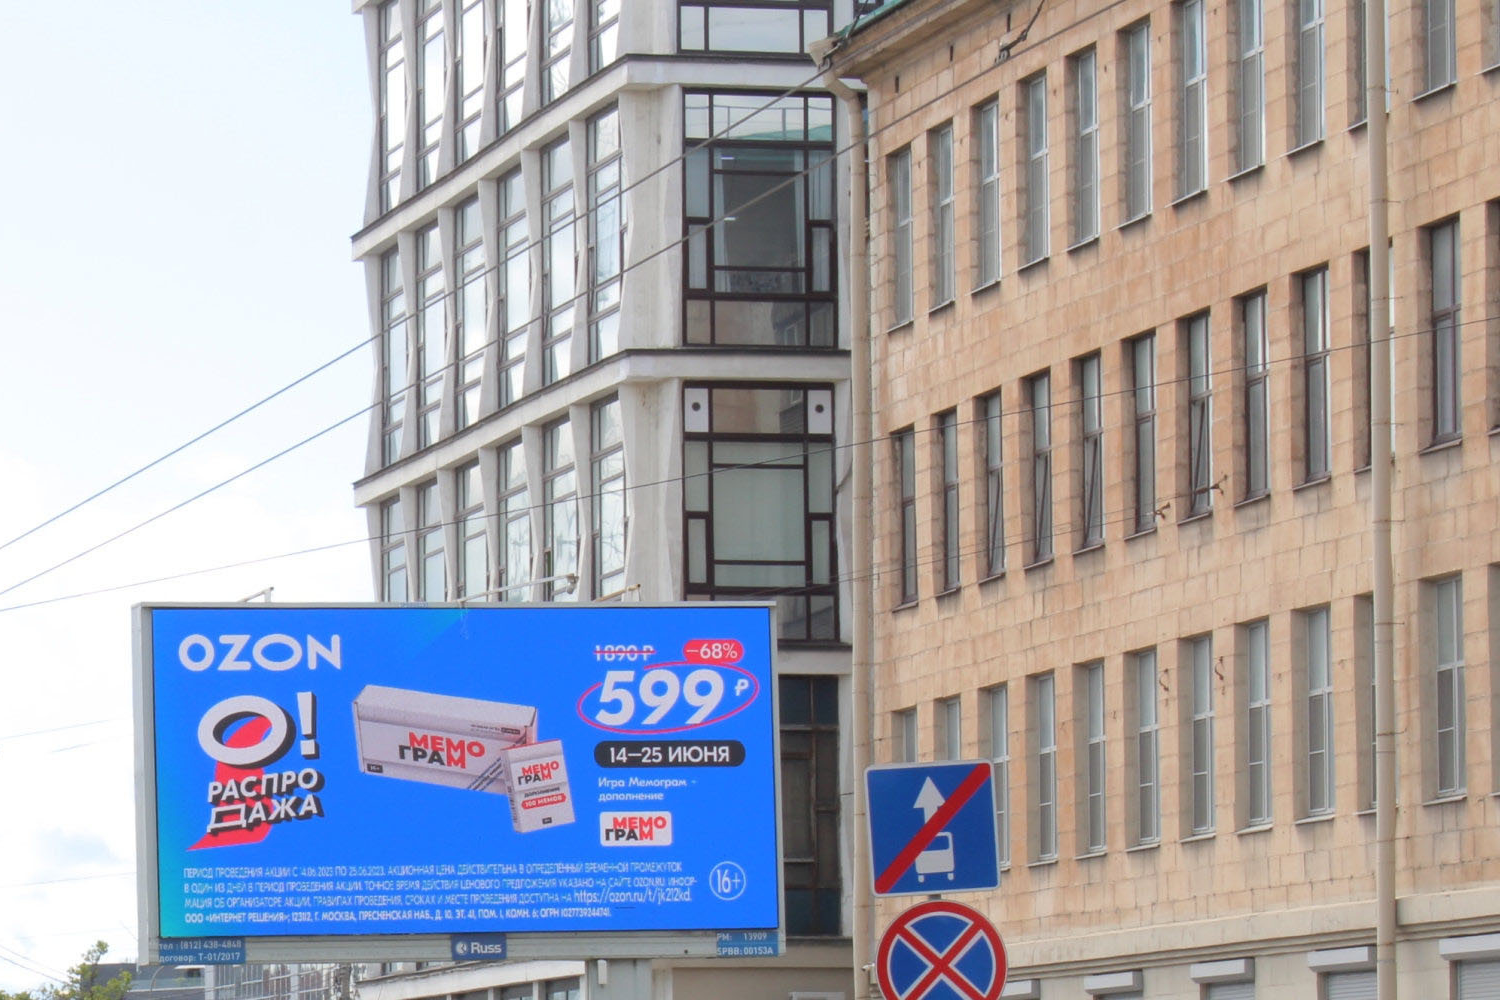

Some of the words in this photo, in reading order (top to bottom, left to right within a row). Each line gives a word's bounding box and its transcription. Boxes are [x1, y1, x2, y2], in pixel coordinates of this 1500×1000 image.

[178, 633, 342, 672] OZON
[595, 668, 724, 727] 599
[197, 691, 320, 768] О!
[408, 731, 486, 757] МЕМО
[398, 744, 467, 769] ГРАМ
[668, 746, 730, 762] ИЮНЯ
[521, 760, 560, 775] МЕМО
[208, 767, 323, 805] РАСПРО
[517, 773, 553, 786] ГРАМ
[598, 778, 625, 788] Игра
[628, 776, 687, 788] Мемограм
[598, 791, 664, 802] дополнение
[207, 793, 323, 836] ДАЖА
[613, 816, 667, 829] МЕМО
[605, 828, 654, 841] ГРАМ
[184, 868, 213, 879] ПЕРИОД
[215, 867, 263, 879] ПРОВЕДЕНИЯ
[265, 867, 291, 878] АКЦИИ
[335, 866, 347, 877] ПО
[388, 865, 434, 876] АКЦИОННАЯ
[436, 864, 455, 876] ЦЕНА
[286, 881, 333, 893] ПРОВЕДЕНИЯ
[396, 880, 420, 891] ВРЕМЯ
[460, 879, 500, 890] ЦЕНОВОГО
[558, 878, 594, 888] УКАЗАНО
[716, 869, 741, 894] 16+
[470, 893, 517, 905] ПРОВЕДЕНИЯ
[185, 913, 204, 923] ООО
[359, 910, 412, 921] ПРЕСНЕНСКАЯ
[540, 908, 559, 918] ОГРН
[181, 940, 201, 949] (812)
[743, 933, 767, 941] 13909
[470, 942, 502, 954] Russ
